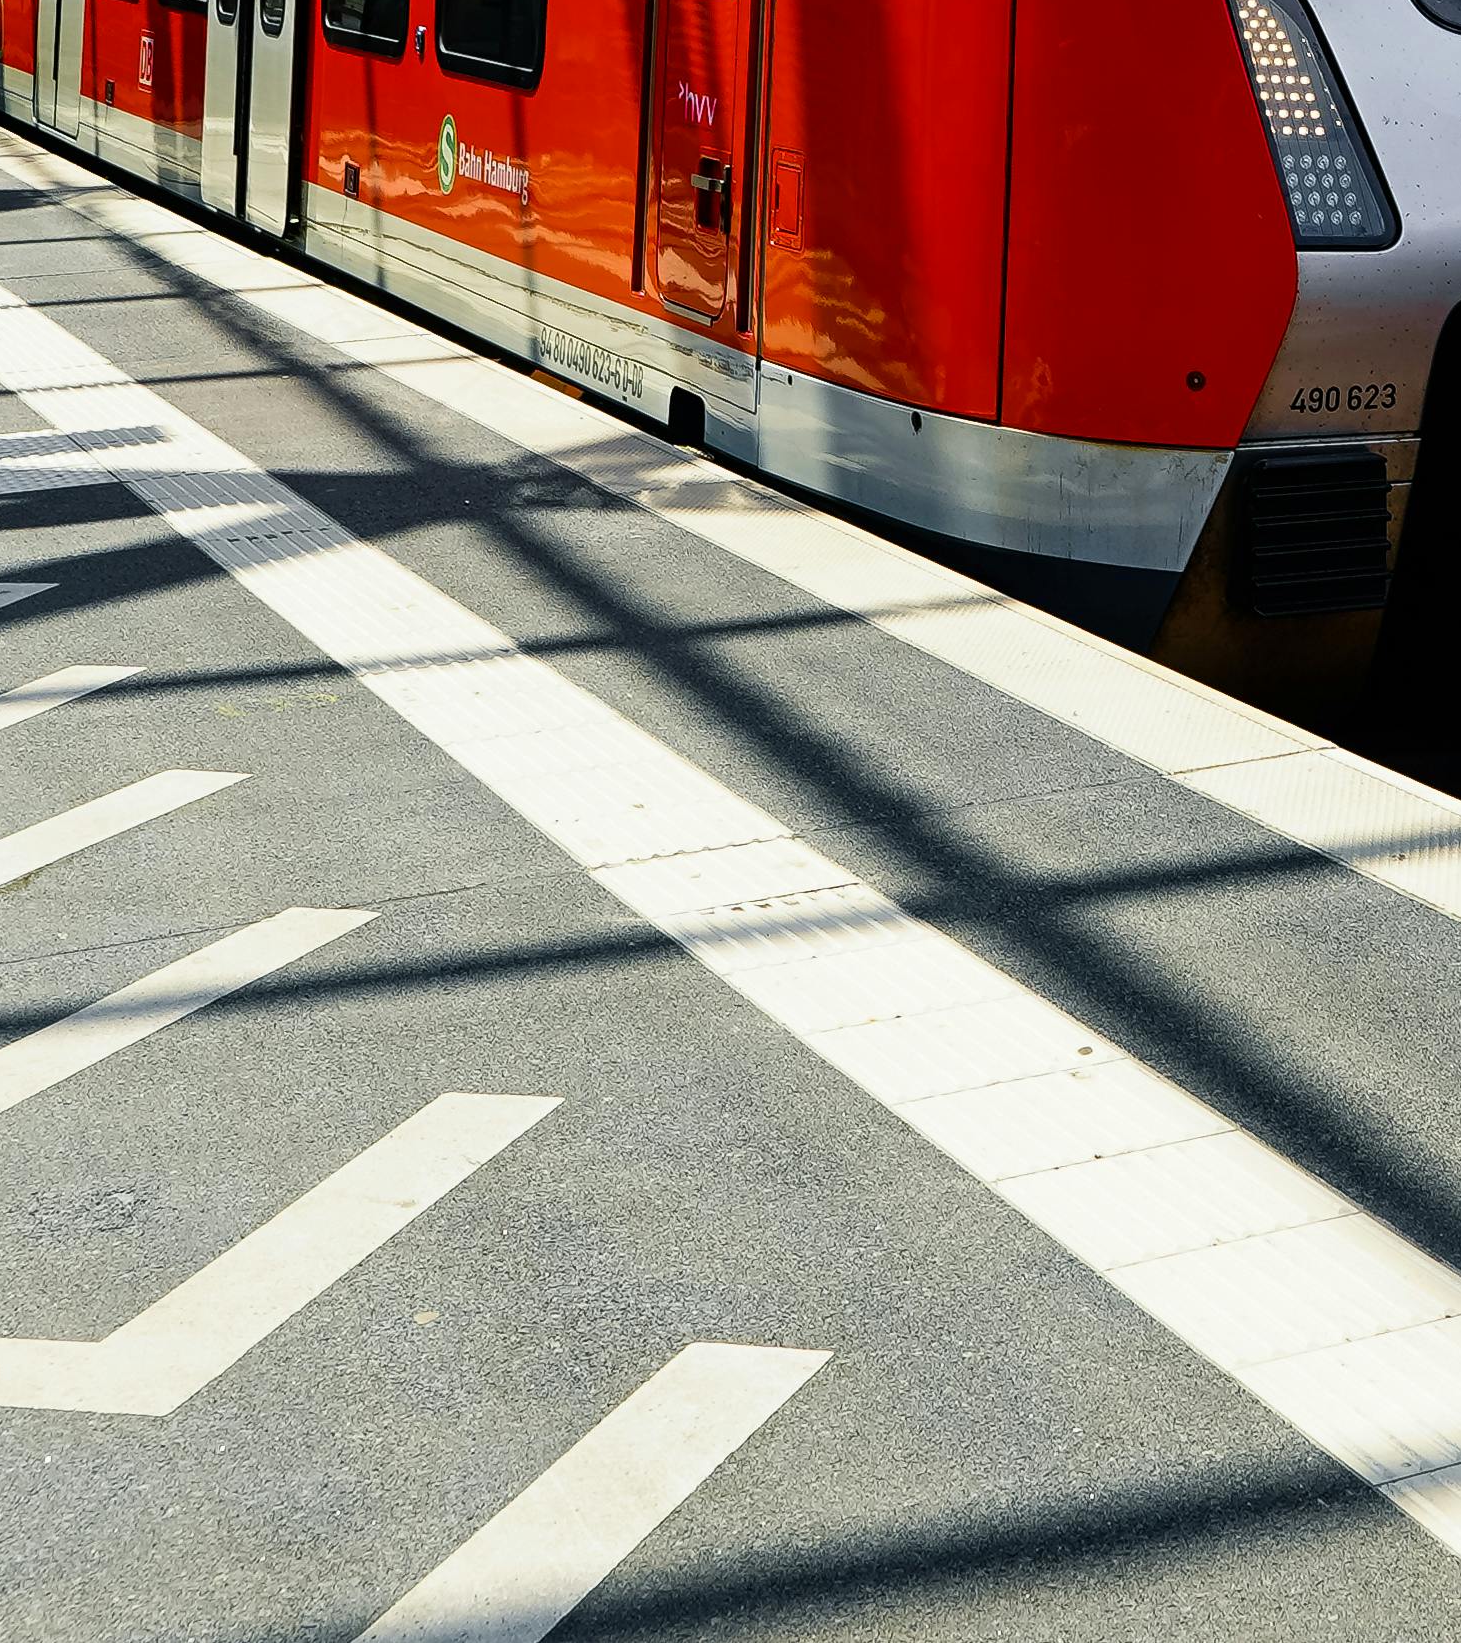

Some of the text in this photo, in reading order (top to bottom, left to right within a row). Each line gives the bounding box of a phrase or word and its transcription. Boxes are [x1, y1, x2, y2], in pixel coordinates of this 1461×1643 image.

[140, 40, 153, 81] DB
[684, 82, 717, 126] hvv
[458, 142, 482, 182] Bahn
[483, 149, 530, 206] Hamburg
[539, 327, 552, 358] 94
[553, 334, 565, 366] 80
[566, 338, 591, 377] 0490
[592, 350, 621, 389] 623-6
[1289, 383, 1397, 413] 490 623
